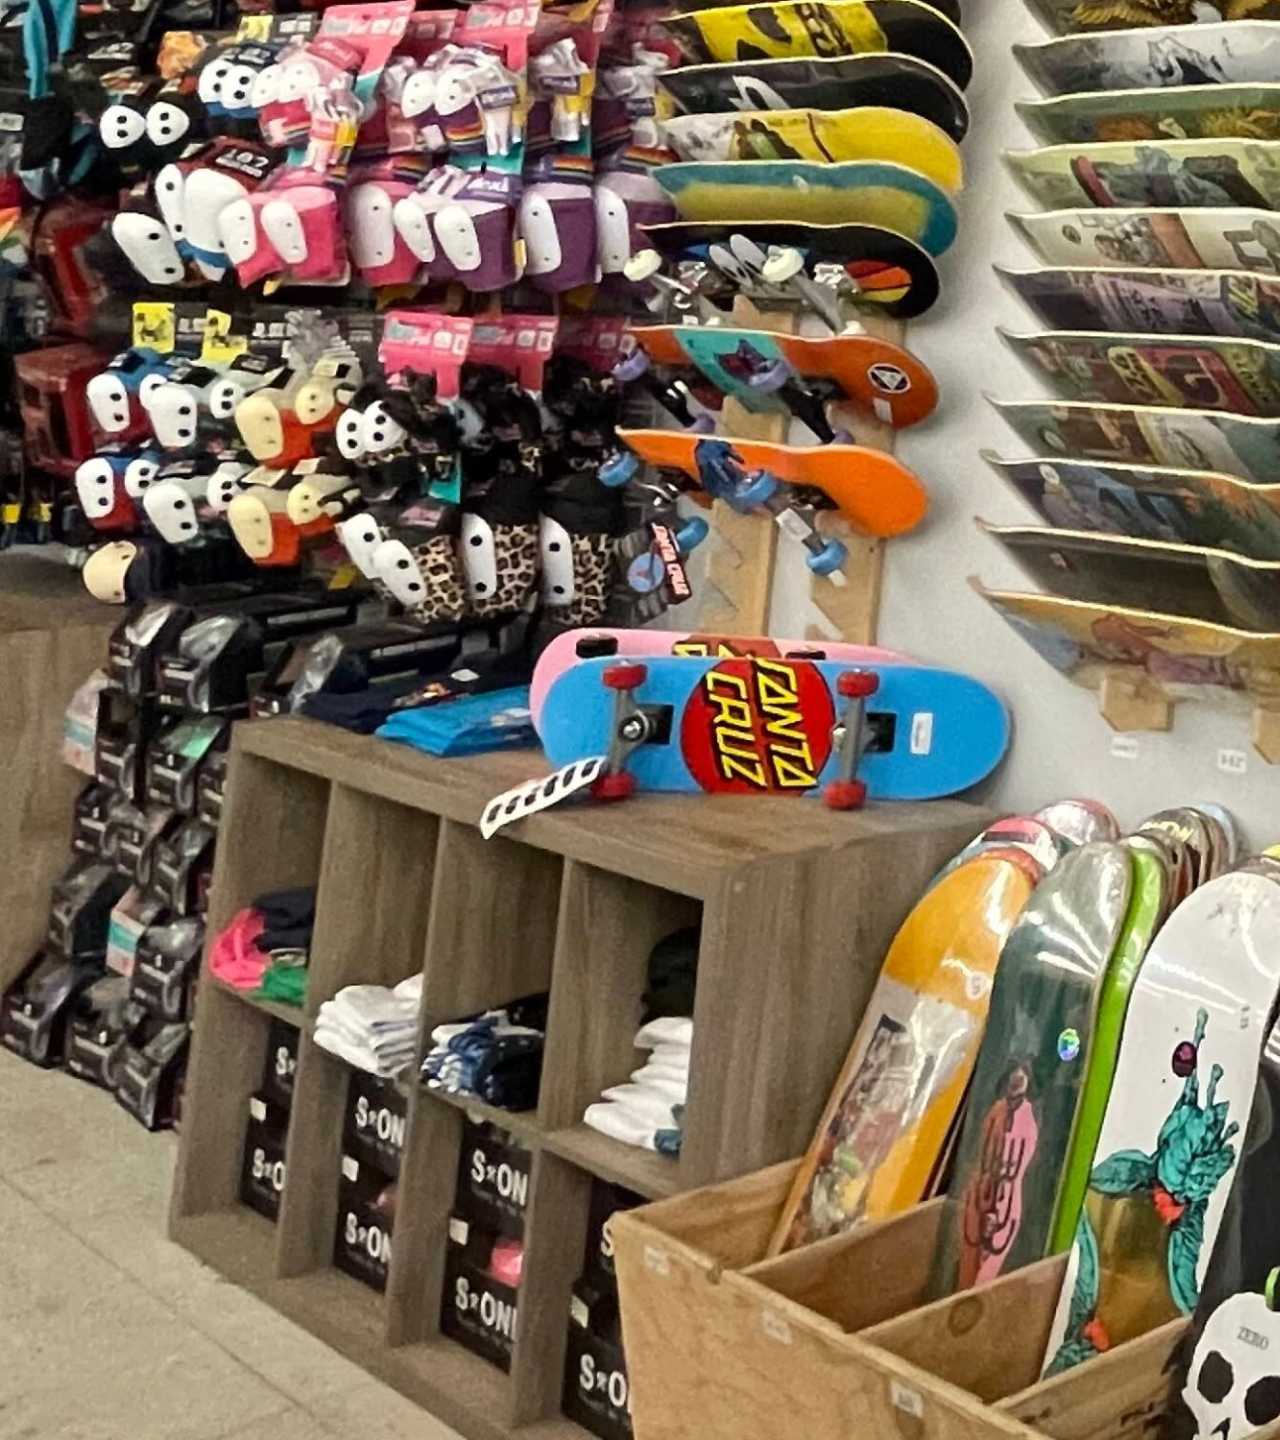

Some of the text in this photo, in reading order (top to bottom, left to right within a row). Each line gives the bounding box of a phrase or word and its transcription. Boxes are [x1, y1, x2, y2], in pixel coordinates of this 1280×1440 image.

[705, 671, 769, 788] CRUZ
[756, 656, 820, 789] SANTA
[1237, 1326, 1270, 1351] ZERO
